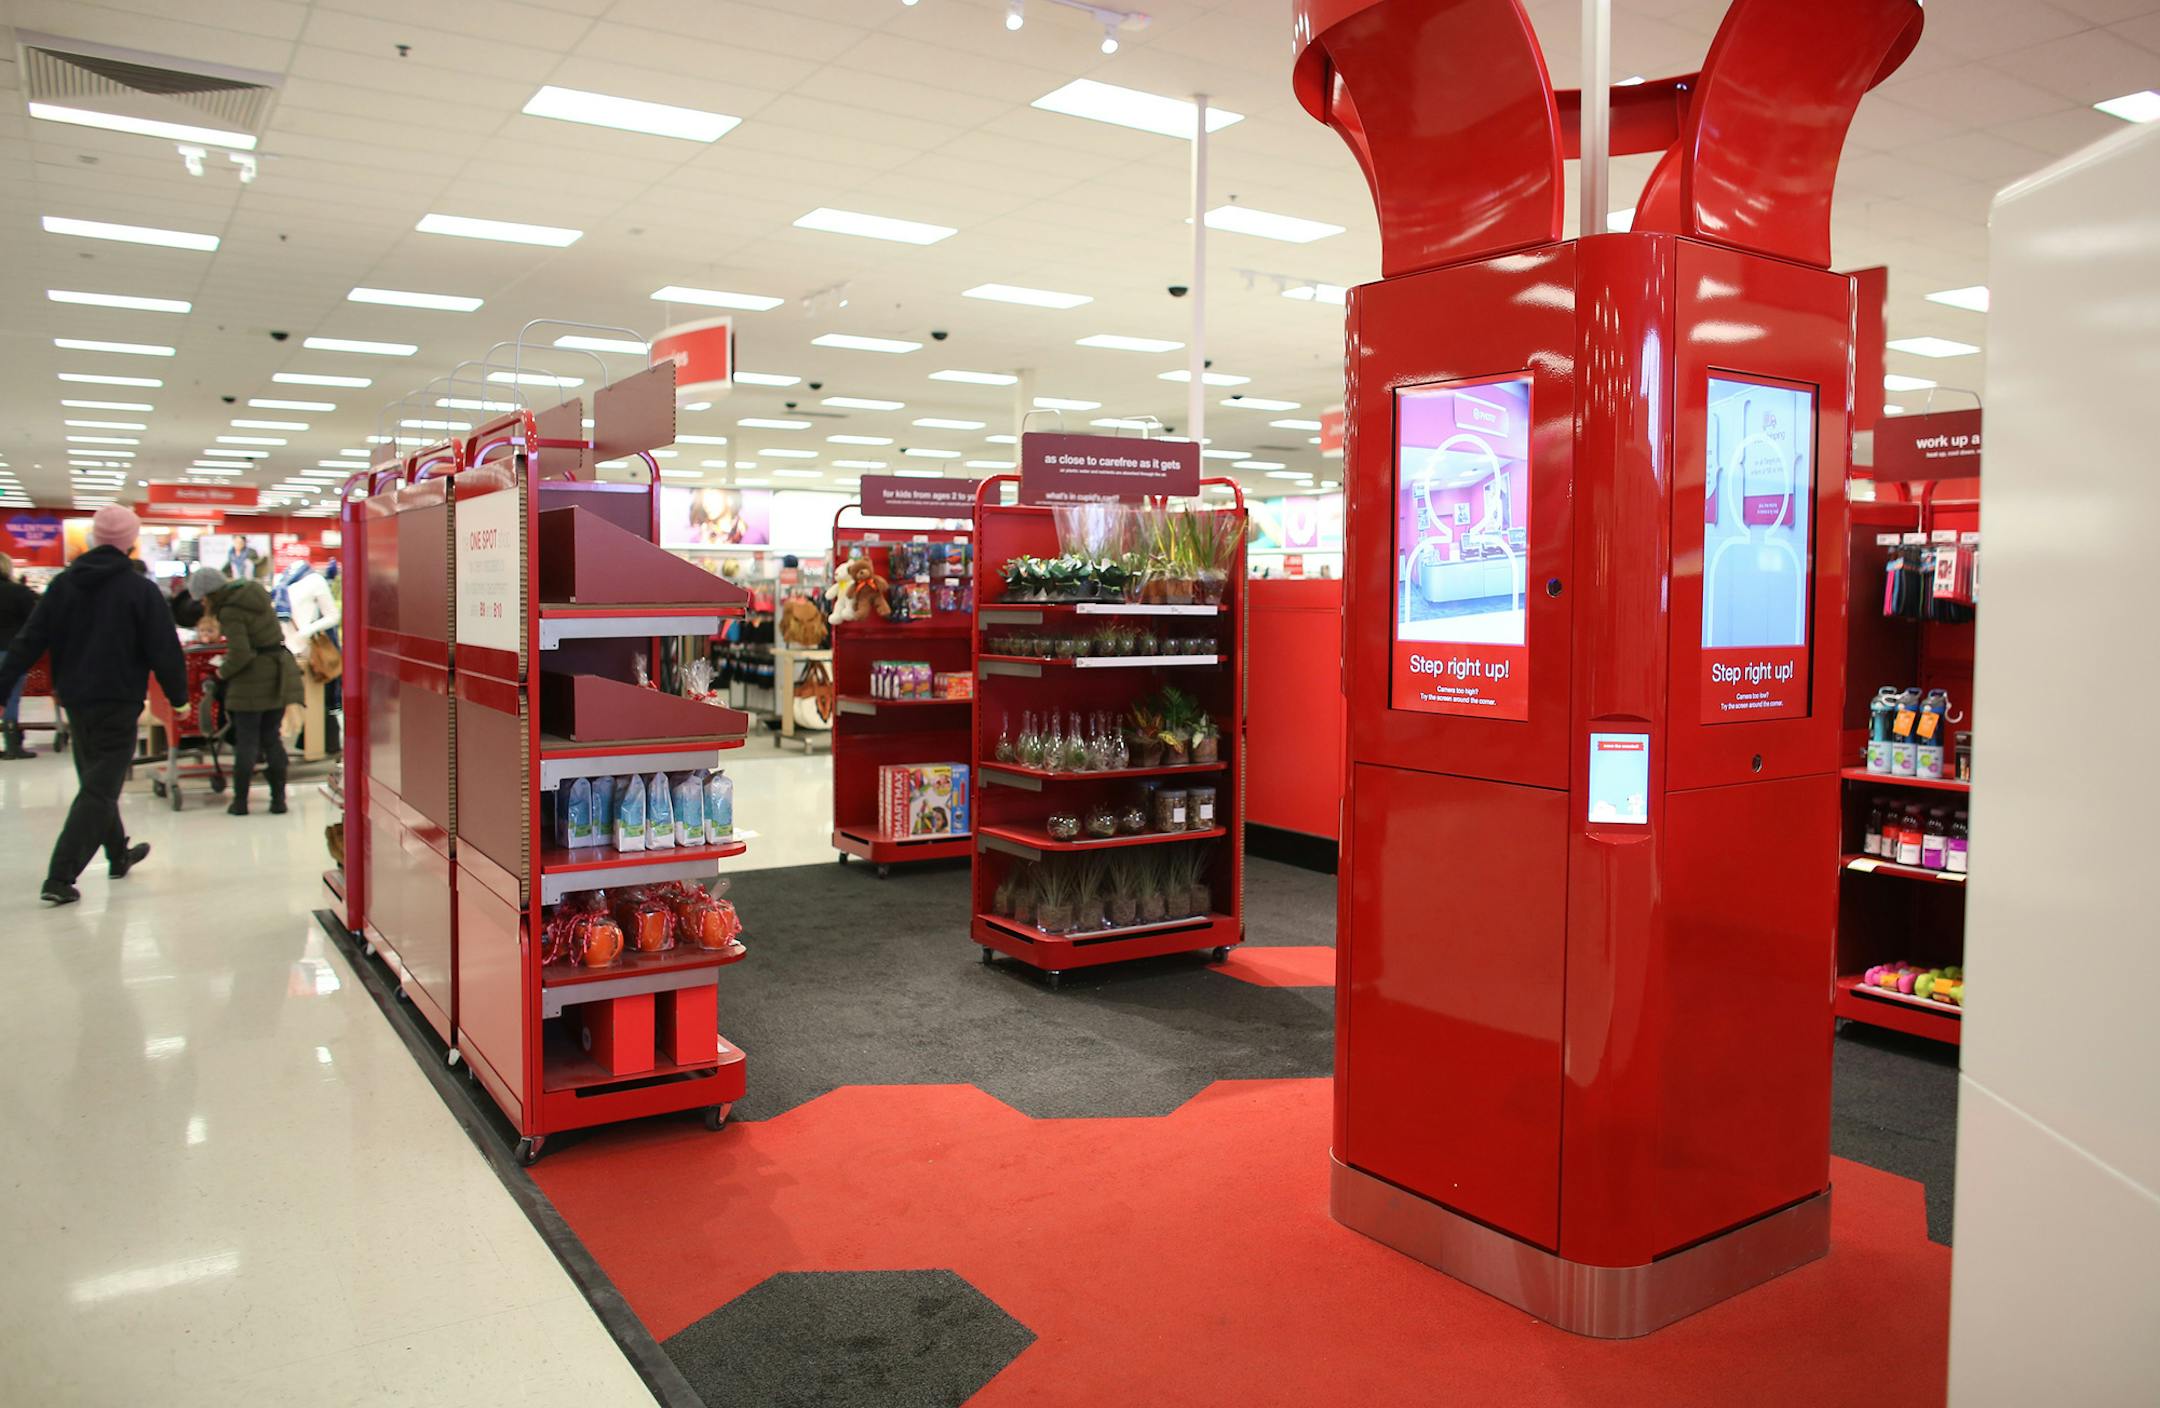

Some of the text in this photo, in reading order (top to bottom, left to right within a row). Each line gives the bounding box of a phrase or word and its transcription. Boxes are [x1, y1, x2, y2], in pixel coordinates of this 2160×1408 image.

[1916, 434, 1948, 449] work
[1951, 434, 1969, 448] up
[1044, 454, 1181, 471] as close to carefree as it gets
[883, 489, 894, 497] for
[895, 490, 912, 498] kids
[913, 491, 931, 499] from
[932, 492, 950, 501] ages
[1045, 492, 1068, 500] what's
[1078, 493, 1100, 502] cupid's
[469, 531, 482, 551] ONE
[482, 528, 498, 550] SPOT
[1410, 655, 1510, 682] Step right up!
[1712, 660, 1794, 686] Step right up!
[1437, 685, 1456, 694] Camera
[1465, 687, 1479, 696] high?
[1736, 692, 1752, 701] Camera
[1420, 692, 1429, 701] Try
[1429, 693, 1437, 701] the
[1453, 695, 1470, 703] around
[1720, 702, 1728, 711] Try
[1735, 702, 1748, 710] screen
[1749, 701, 1763, 709] around
[894, 770, 904, 839] SMARTMAX
